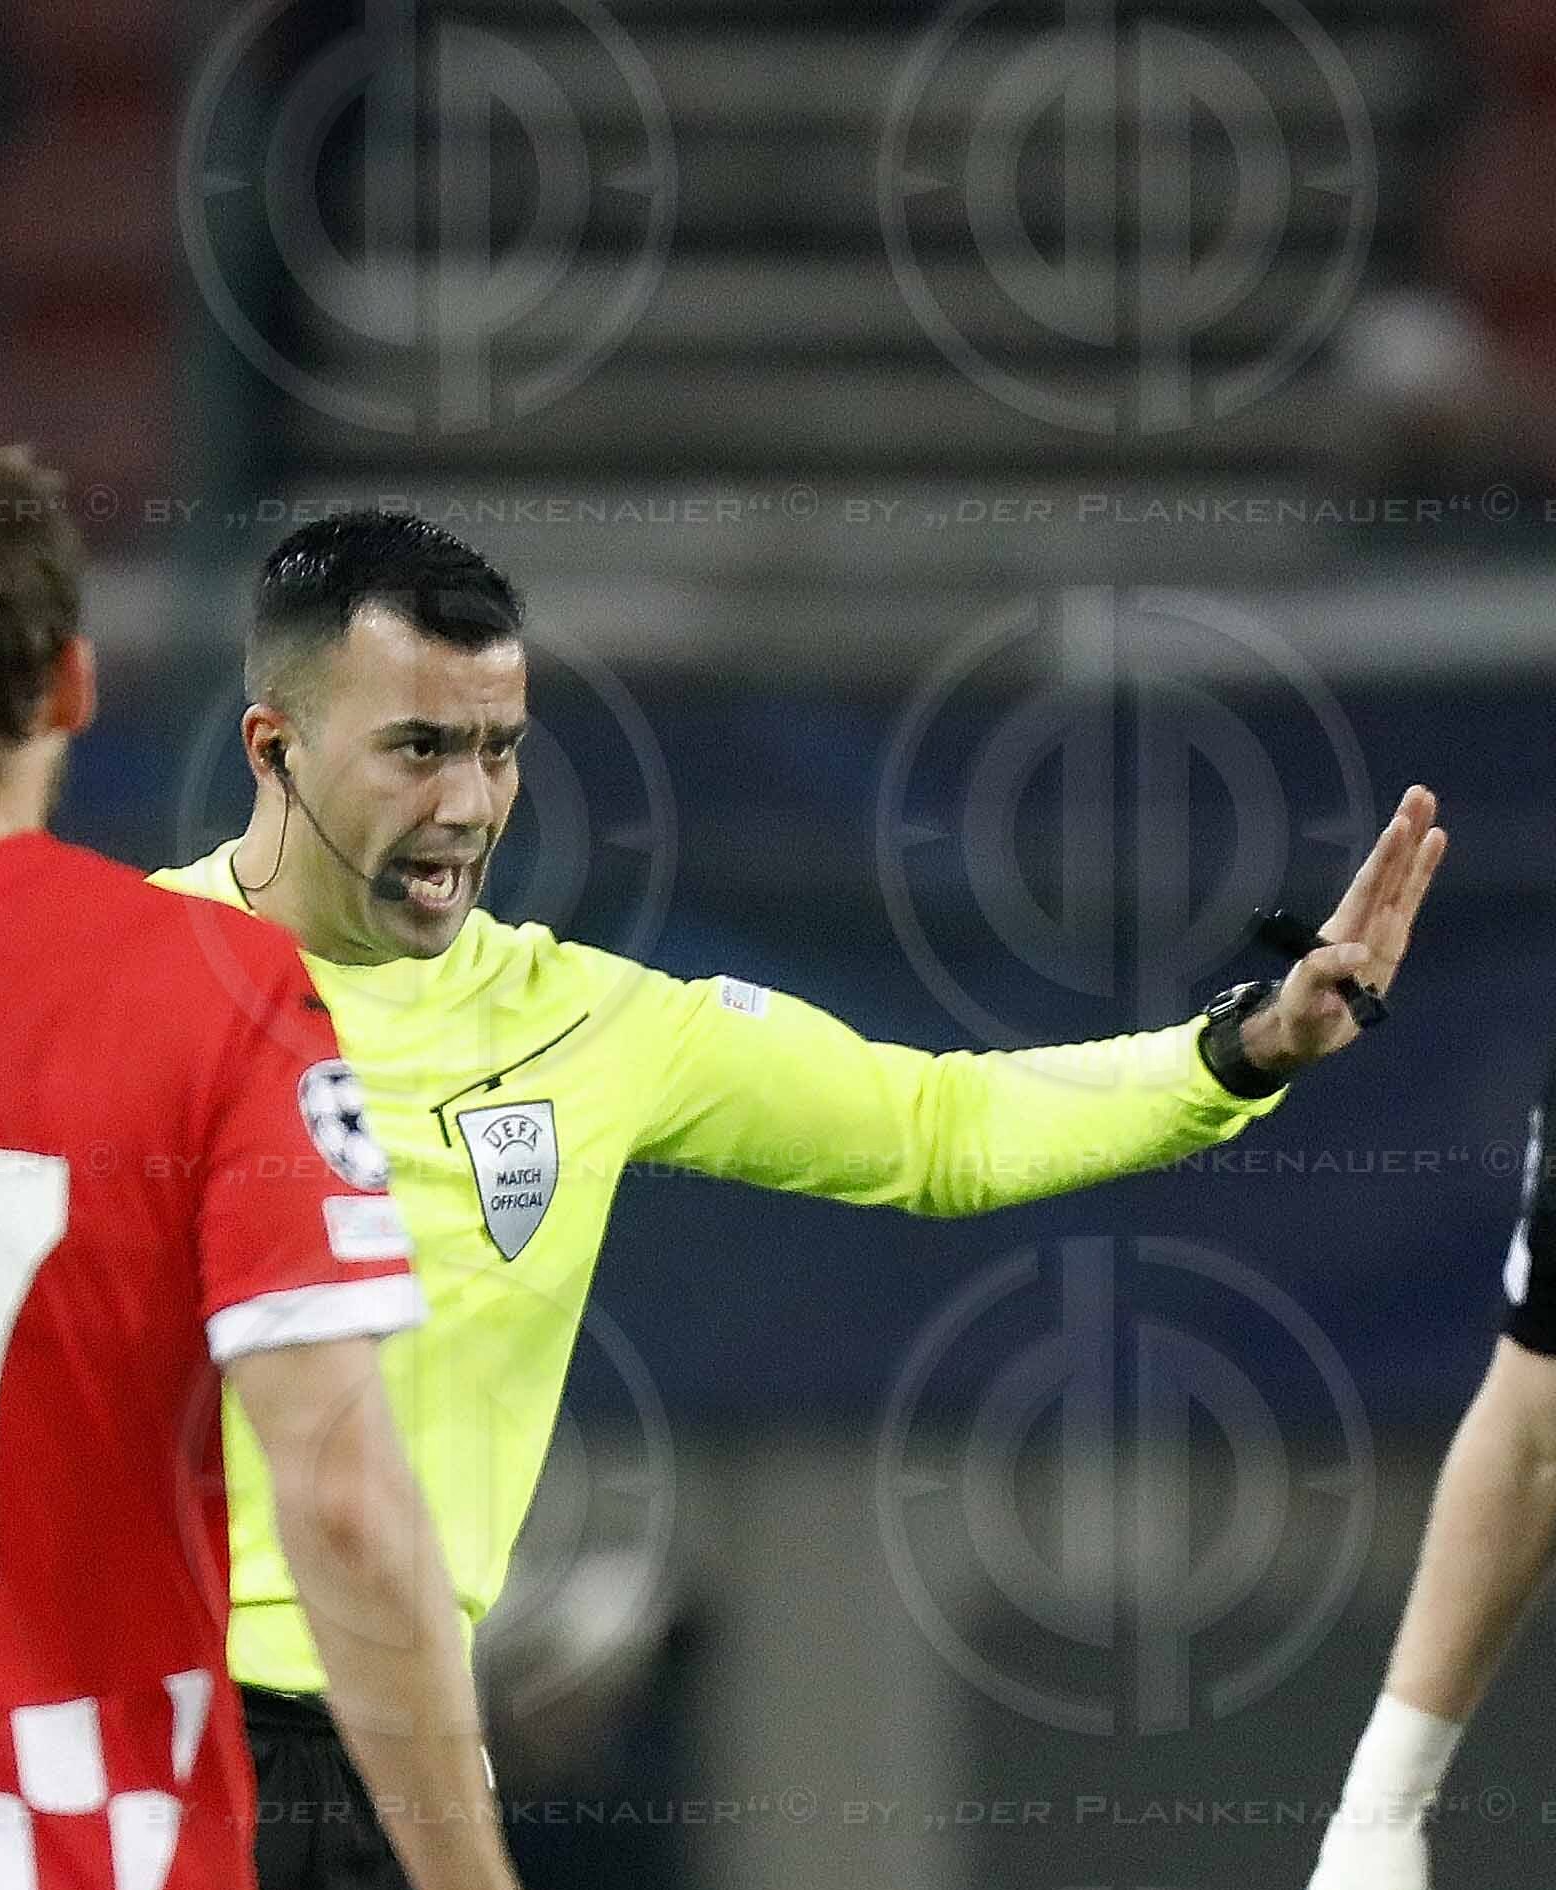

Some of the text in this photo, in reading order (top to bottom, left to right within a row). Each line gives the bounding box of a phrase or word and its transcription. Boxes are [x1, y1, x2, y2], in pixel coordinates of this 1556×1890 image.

[486, 1119, 539, 1149] UEFA
[497, 1168, 541, 1186] MATCH
[491, 1191, 543, 1210] OFFICIAL
